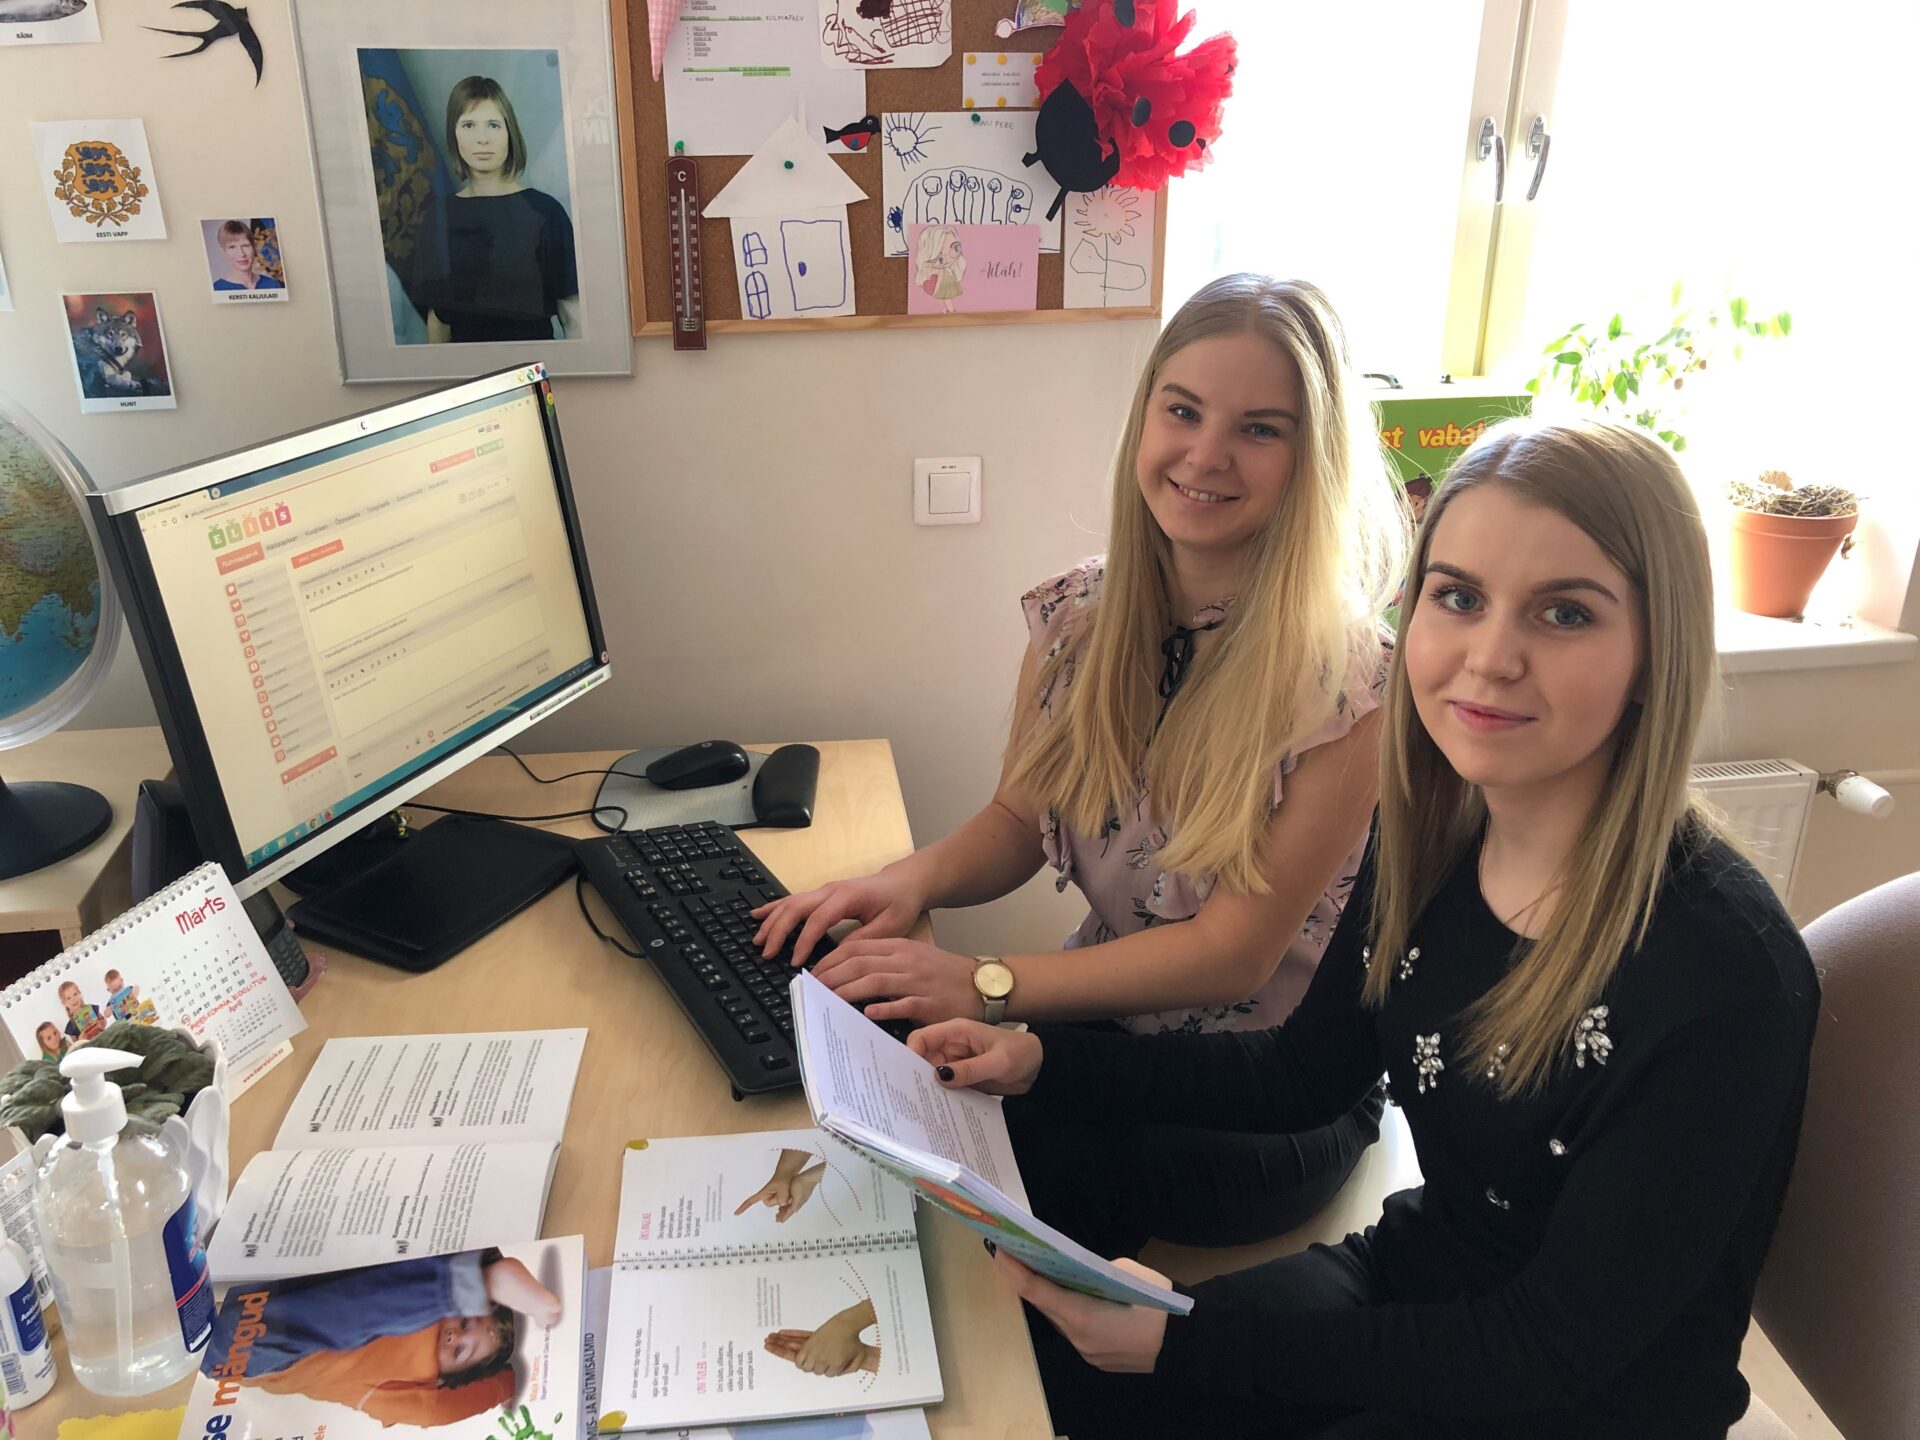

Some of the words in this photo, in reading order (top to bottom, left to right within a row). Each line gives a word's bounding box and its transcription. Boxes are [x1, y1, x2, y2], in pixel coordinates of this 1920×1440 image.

[228, 293, 248, 301] KERSTI
[248, 292, 279, 300] KALJULAID
[175, 896, 226, 935] Märts
[213, 1290, 270, 1407] mängud
[582, 1332, 597, 1401] RÜTMISALMID
[696, 1360, 707, 1381] TULEB
[696, 1382, 707, 1393] UNI
[716, 1383, 724, 1392] Uni
[585, 1402, 597, 1415] JA
